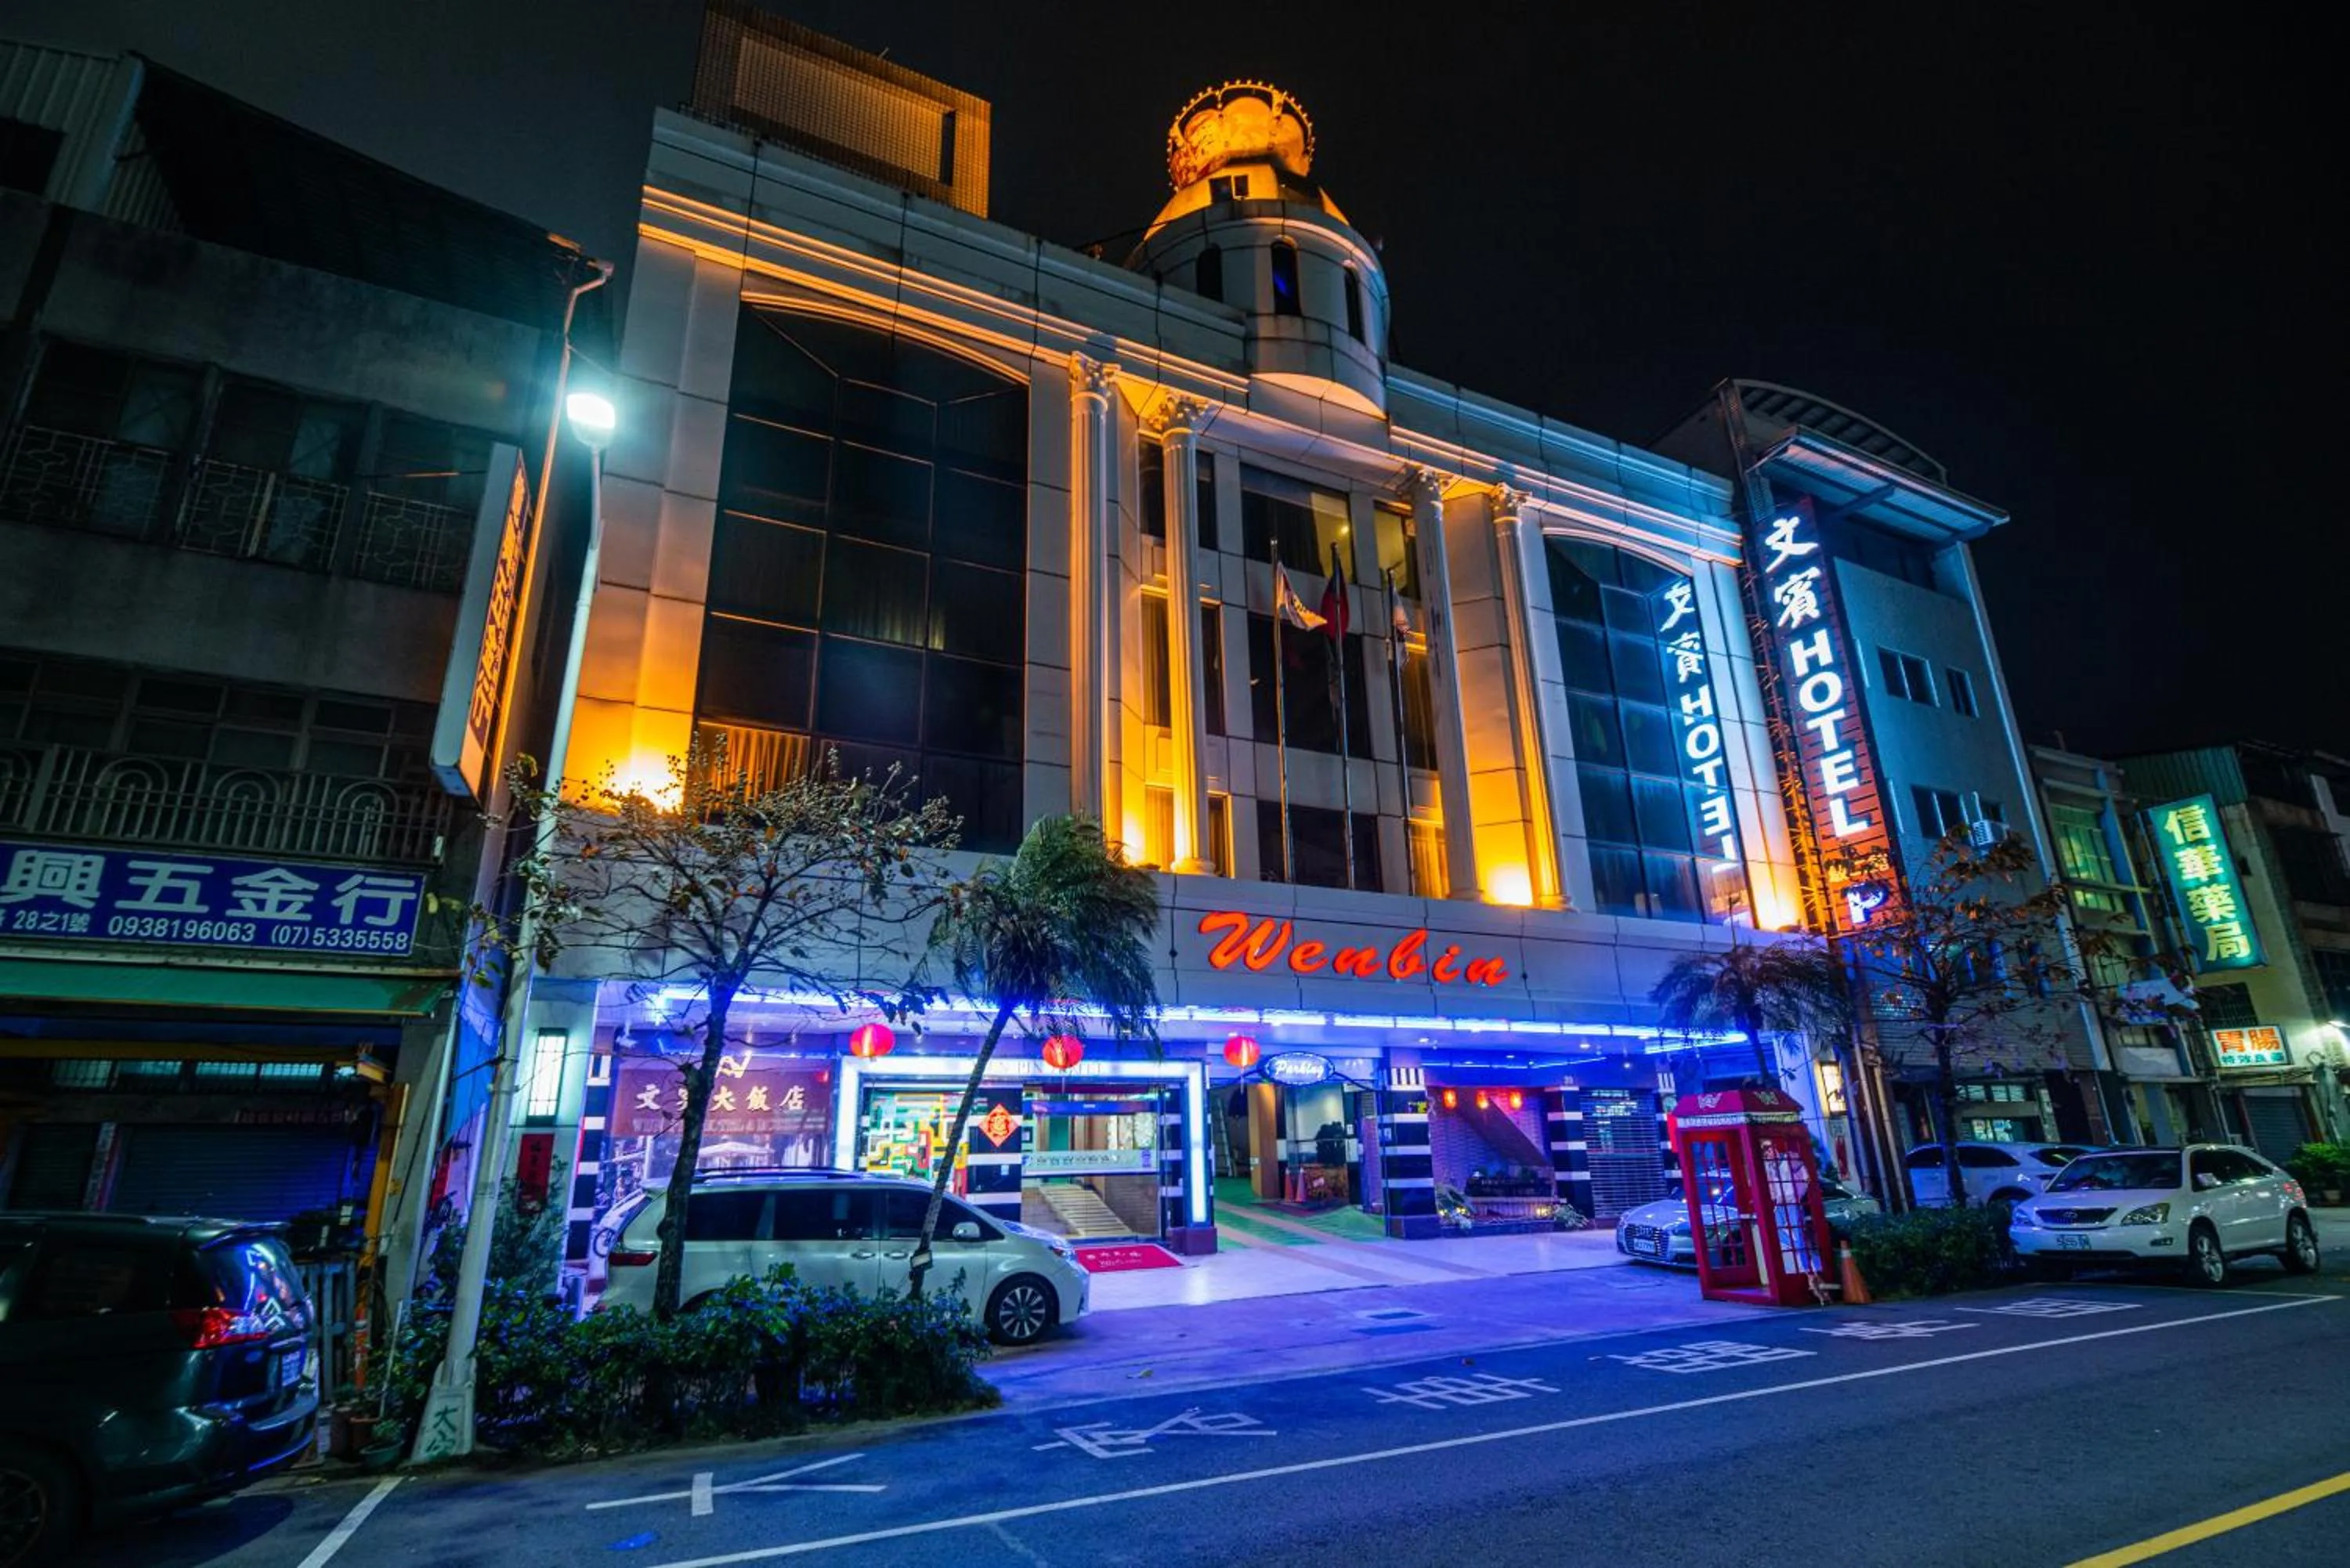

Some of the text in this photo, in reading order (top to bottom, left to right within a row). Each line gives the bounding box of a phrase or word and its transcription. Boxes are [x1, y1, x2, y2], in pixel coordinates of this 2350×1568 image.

[1764, 516, 1821, 629] 文賓
[1791, 629, 1869, 837] HOTEL
[0, 849, 417, 927] 興五金行
[2164, 804, 2251, 961] 信華藥局
[108, 916, 255, 941] 0938196063
[271, 925, 409, 949] (07)5335558
[1198, 911, 1510, 987] Wenbin
